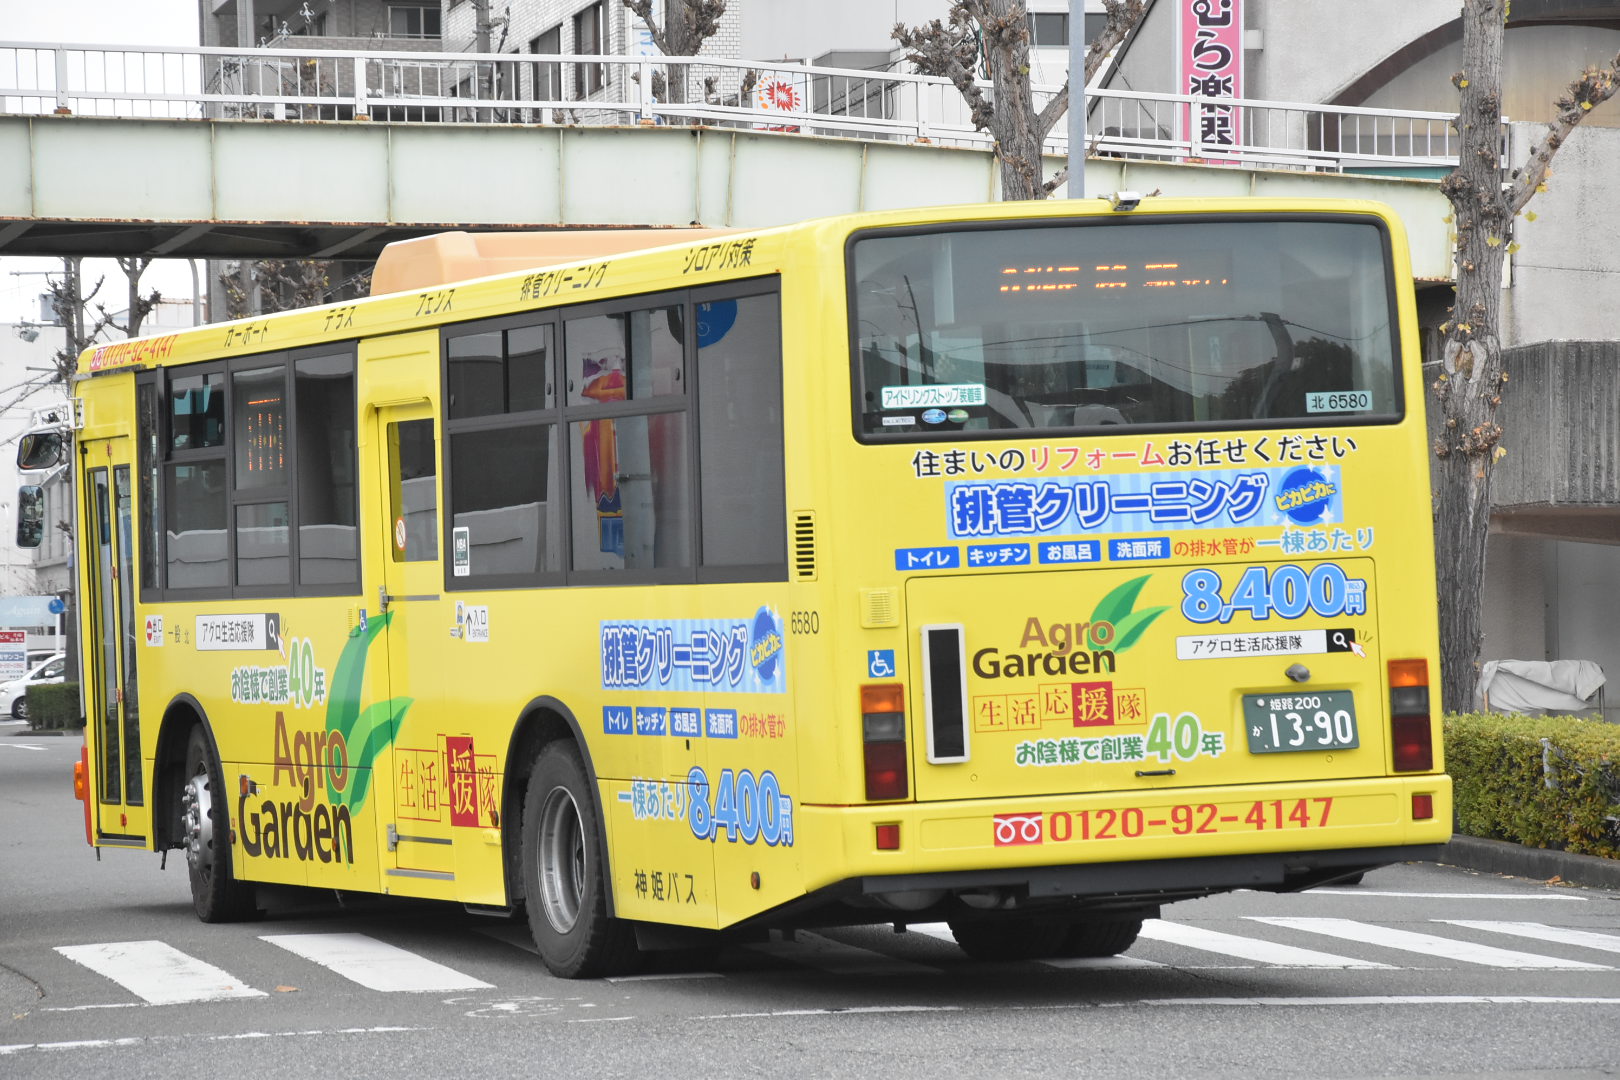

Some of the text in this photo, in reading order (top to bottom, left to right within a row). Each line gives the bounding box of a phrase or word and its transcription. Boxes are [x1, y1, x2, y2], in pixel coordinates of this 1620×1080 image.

[683, 238, 757, 274] シロアリ対策
[324, 306, 356, 332] テラス
[416, 289, 455, 316] フェンス
[102, 334, 179, 367] 0120-92-4147
[885, 387, 982, 406] アイドリングストップ装着車
[1329, 394, 1368, 409] 6580
[952, 472, 1269, 537] 排管クリーニング
[906, 551, 951, 568] トイレ
[969, 548, 1028, 564] キッチン
[1047, 544, 1093, 561] お風呂
[1116, 540, 1162, 558] 洗面所
[1174, 537, 1255, 557] の排水管が
[202, 620, 255, 644] アグロ生活応援隊
[473, 609, 487, 626] 入口
[791, 611, 820, 635] 6580
[1019, 616, 1116, 657] Agro
[1191, 634, 1303, 654] アグロ生活応援隊
[602, 624, 748, 687] 排管クリーニング
[972, 642, 1117, 680] Garden
[608, 711, 629, 731] トイレ
[636, 712, 667, 732] キッチン
[674, 712, 698, 734] お風呂
[709, 712, 734, 736] 洗面所
[979, 684, 1142, 729] 生活応援隊
[1252, 709, 1354, 748] か 13-90
[273, 710, 348, 813] Agro
[238, 780, 354, 865] Garden
[1049, 797, 1334, 842] 0120-92-4147
[634, 869, 697, 905] 神姫バス
